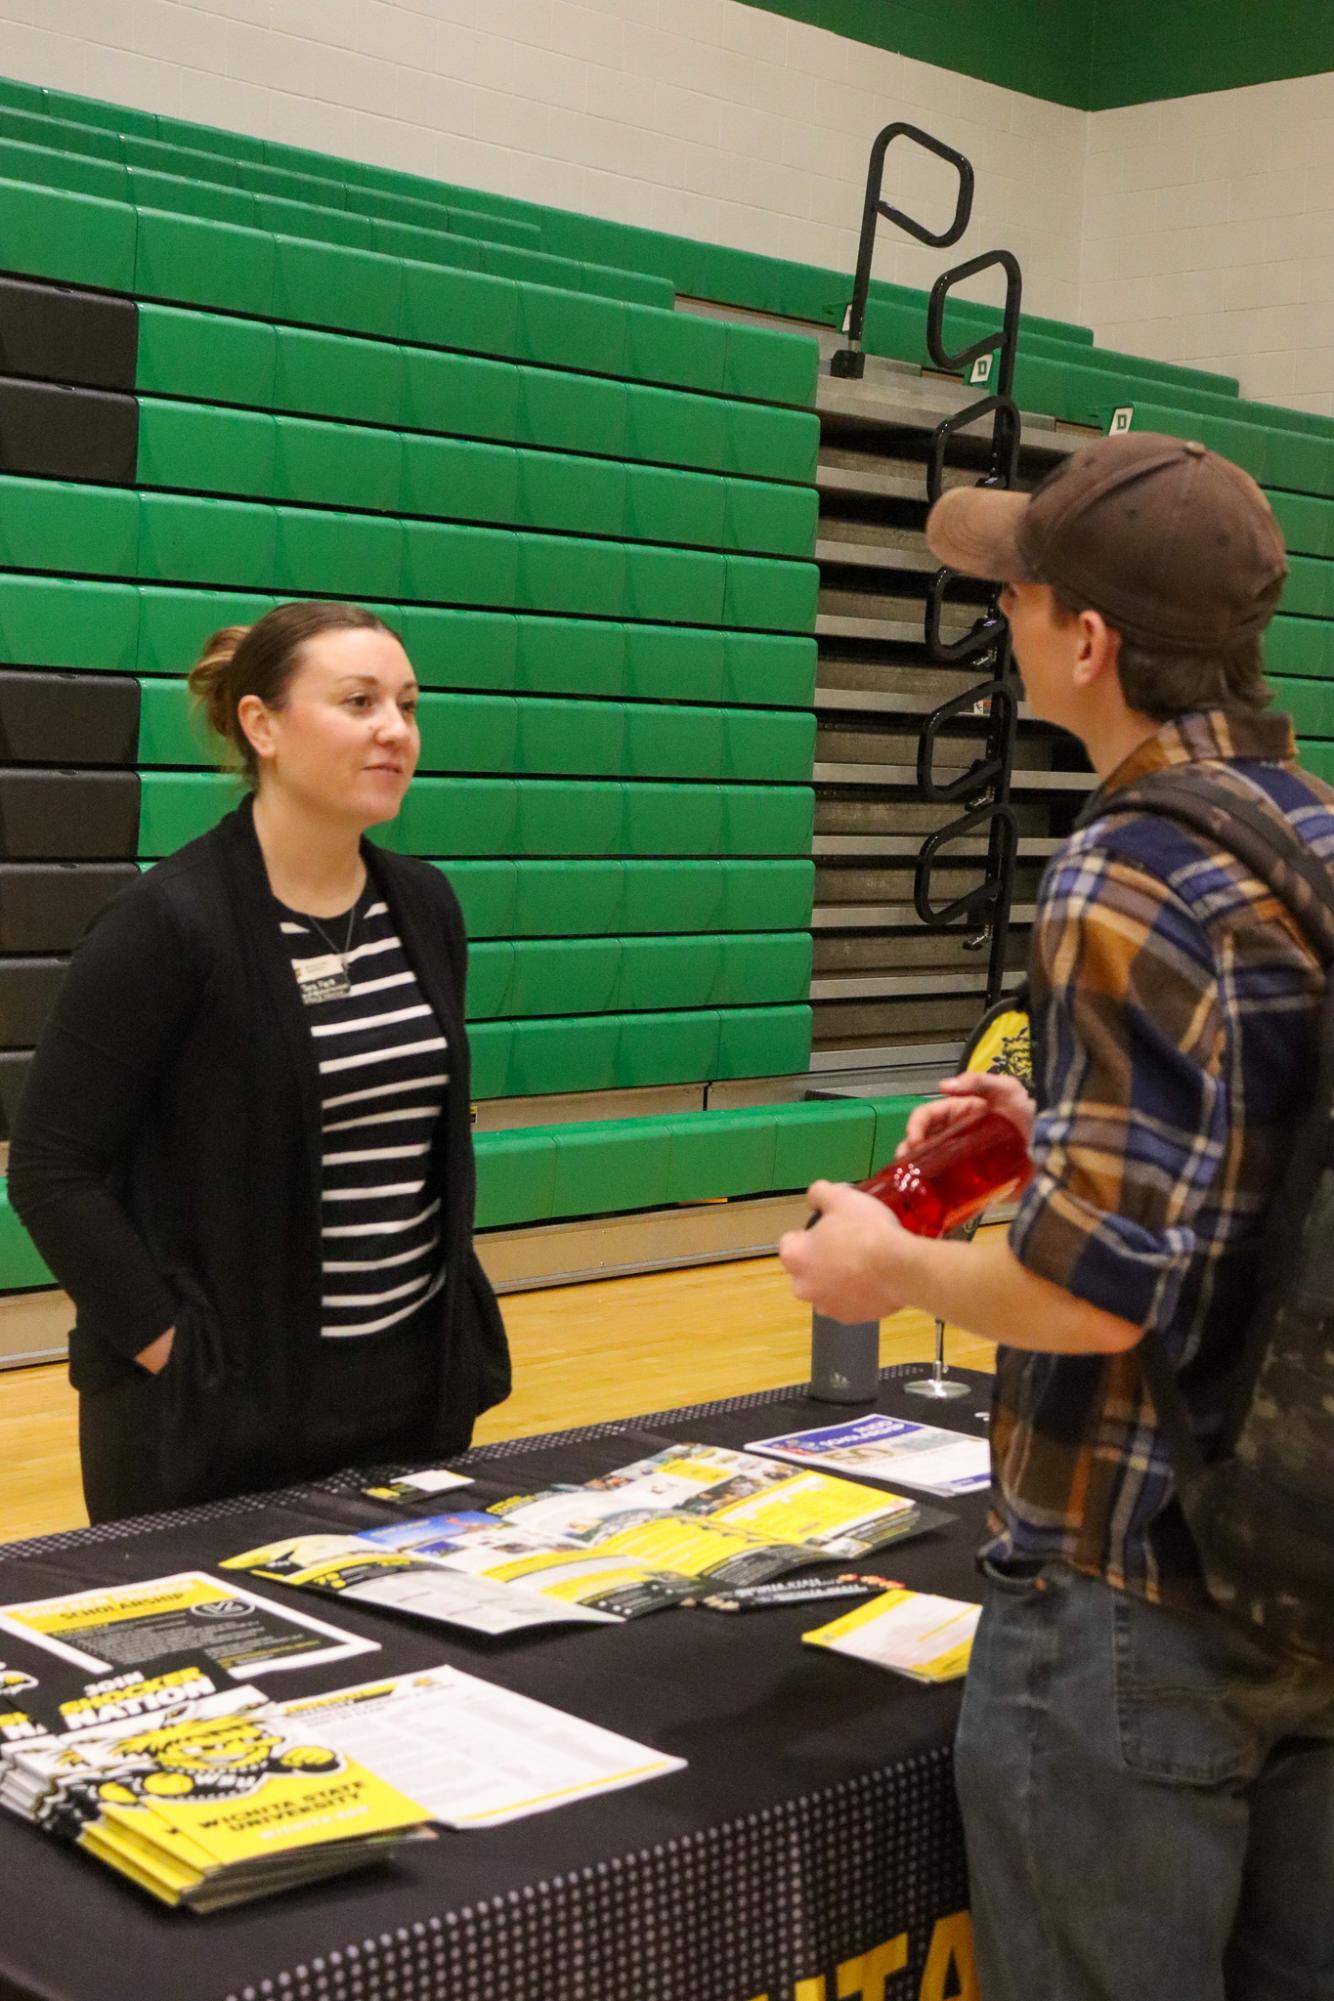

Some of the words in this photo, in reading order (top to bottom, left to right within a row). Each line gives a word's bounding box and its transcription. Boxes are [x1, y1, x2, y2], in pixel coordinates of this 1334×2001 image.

[59, 1592, 184, 1620] SCHOLARSHIP
[59, 1667, 200, 1715] SHOCKER
[62, 1676, 216, 1730] NATION
[84, 1671, 145, 1697] JOIN
[199, 1800, 295, 1829] WICHITA
[302, 1780, 364, 1802] STATE
[229, 1792, 360, 1832] UNIVERSITY
